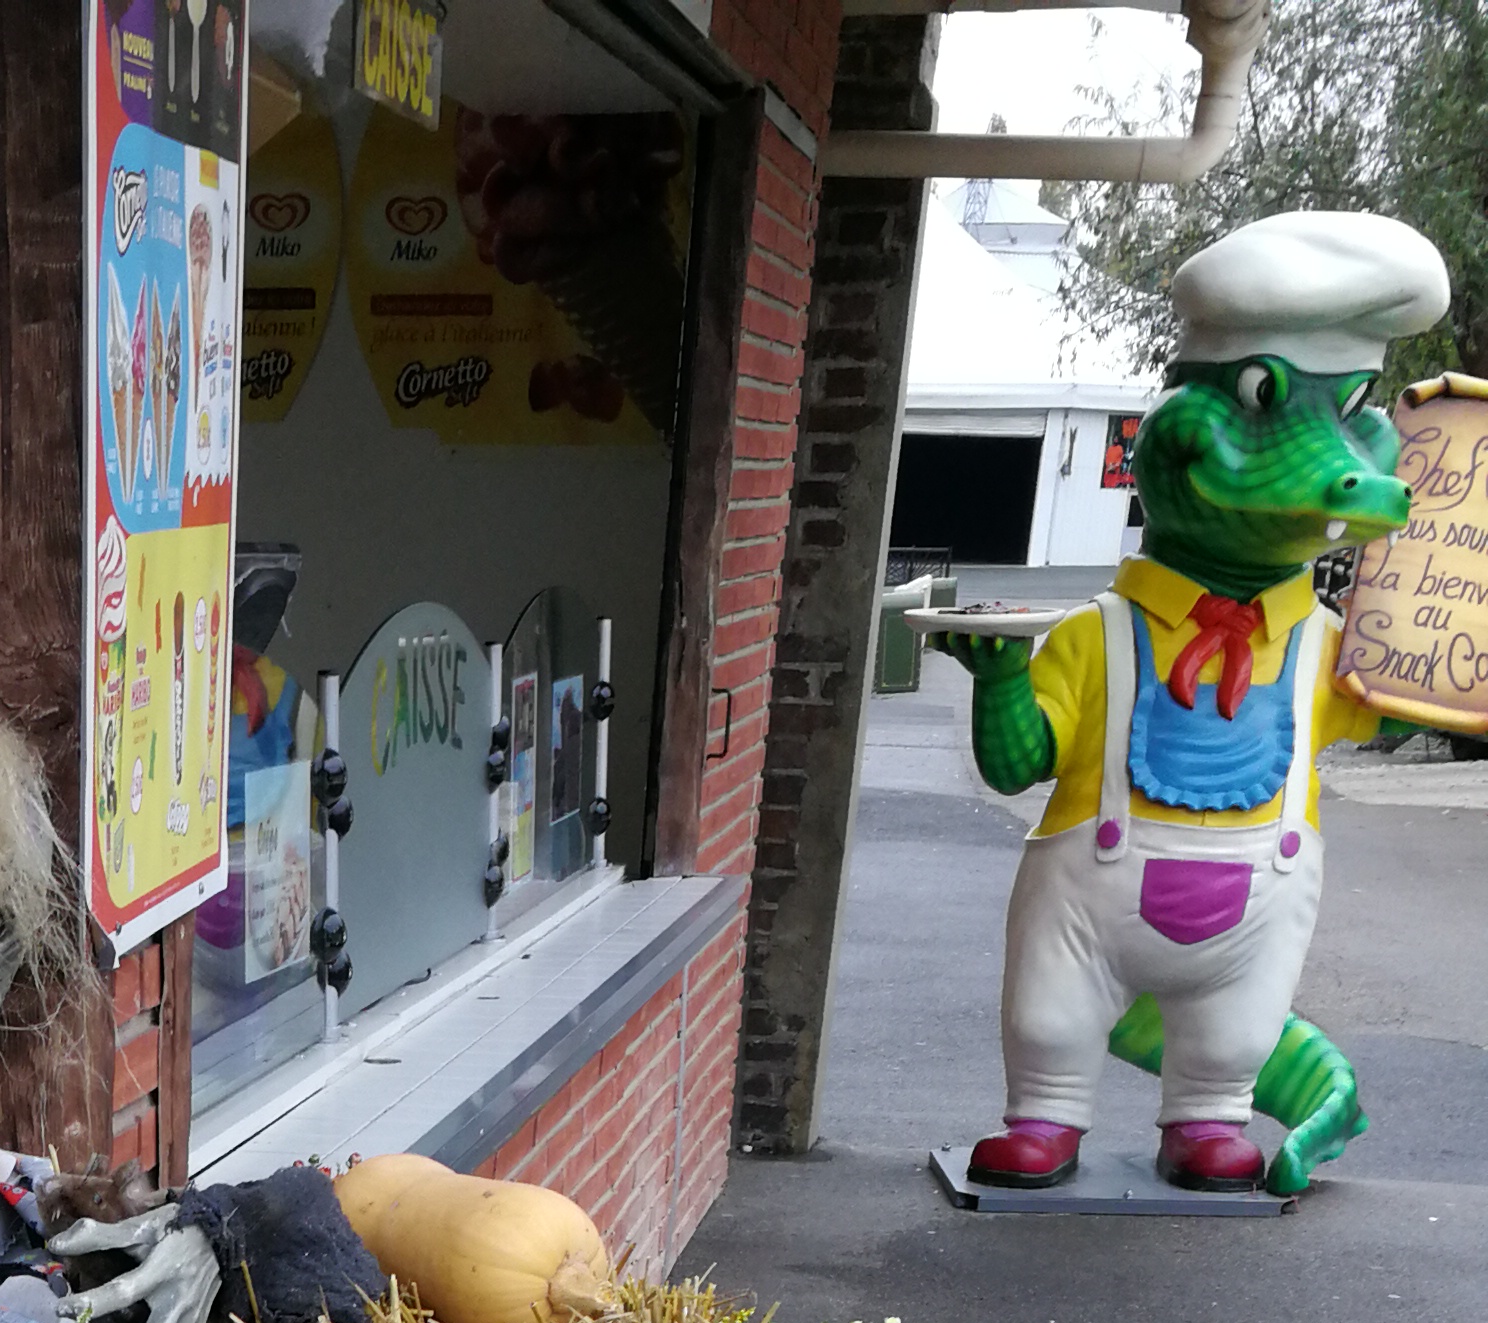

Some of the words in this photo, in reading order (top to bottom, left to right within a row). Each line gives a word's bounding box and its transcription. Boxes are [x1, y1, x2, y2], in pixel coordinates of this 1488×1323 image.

[364, 0, 436, 116] CAISSE
[255, 235, 302, 258] Miko
[390, 238, 438, 262] Miko
[398, 356, 488, 403] Cornetto
[1398, 515, 1438, 543] ous
[1442, 522, 1488, 554] sou
[1413, 605, 1453, 631] au
[1351, 609, 1444, 693] Snack
[370, 629, 467, 777] CAISSE
